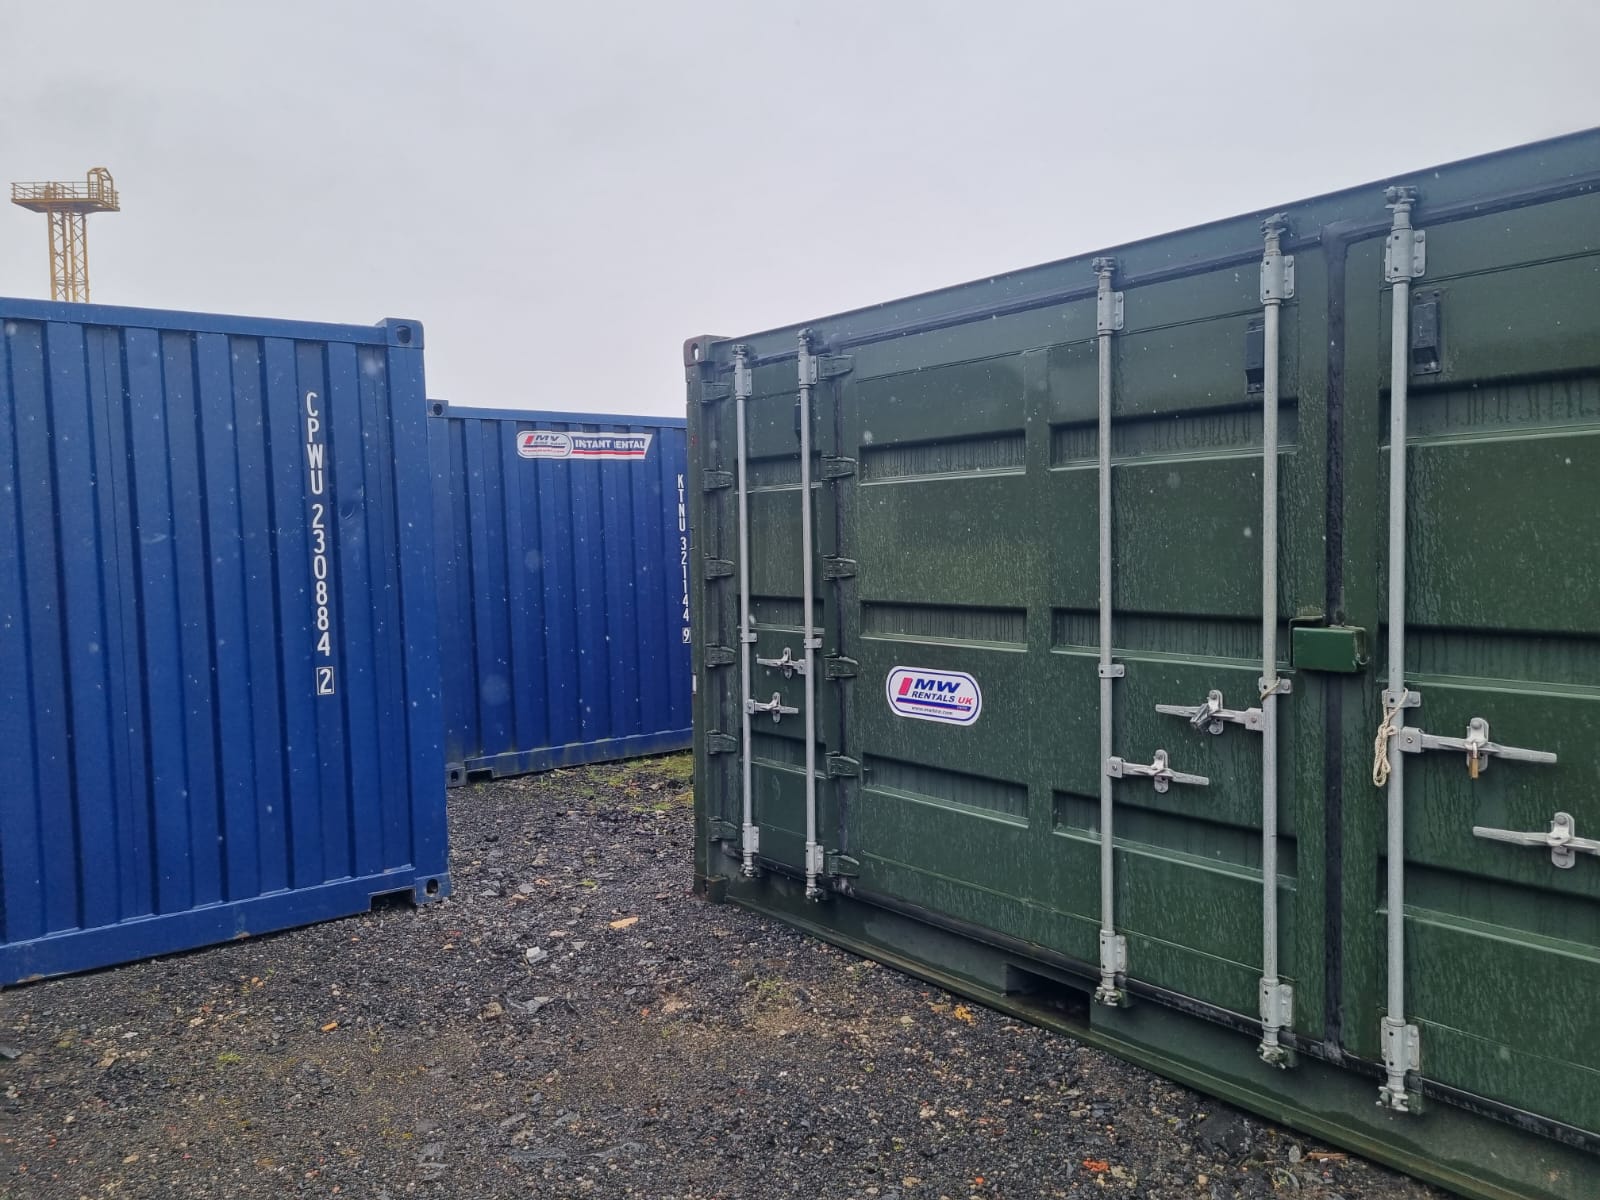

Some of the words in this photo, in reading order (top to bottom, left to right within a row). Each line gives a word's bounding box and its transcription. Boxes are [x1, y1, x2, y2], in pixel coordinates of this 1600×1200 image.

[306, 392, 323, 494] CPWU
[677, 473, 686, 532] KTNU
[312, 503, 331, 656] 230884
[680, 536, 689, 622] 321144
[318, 667, 333, 694] 2
[911, 690, 955, 703] RENTALS
[957, 696, 973, 705] UK
[914, 678, 961, 694] MW
